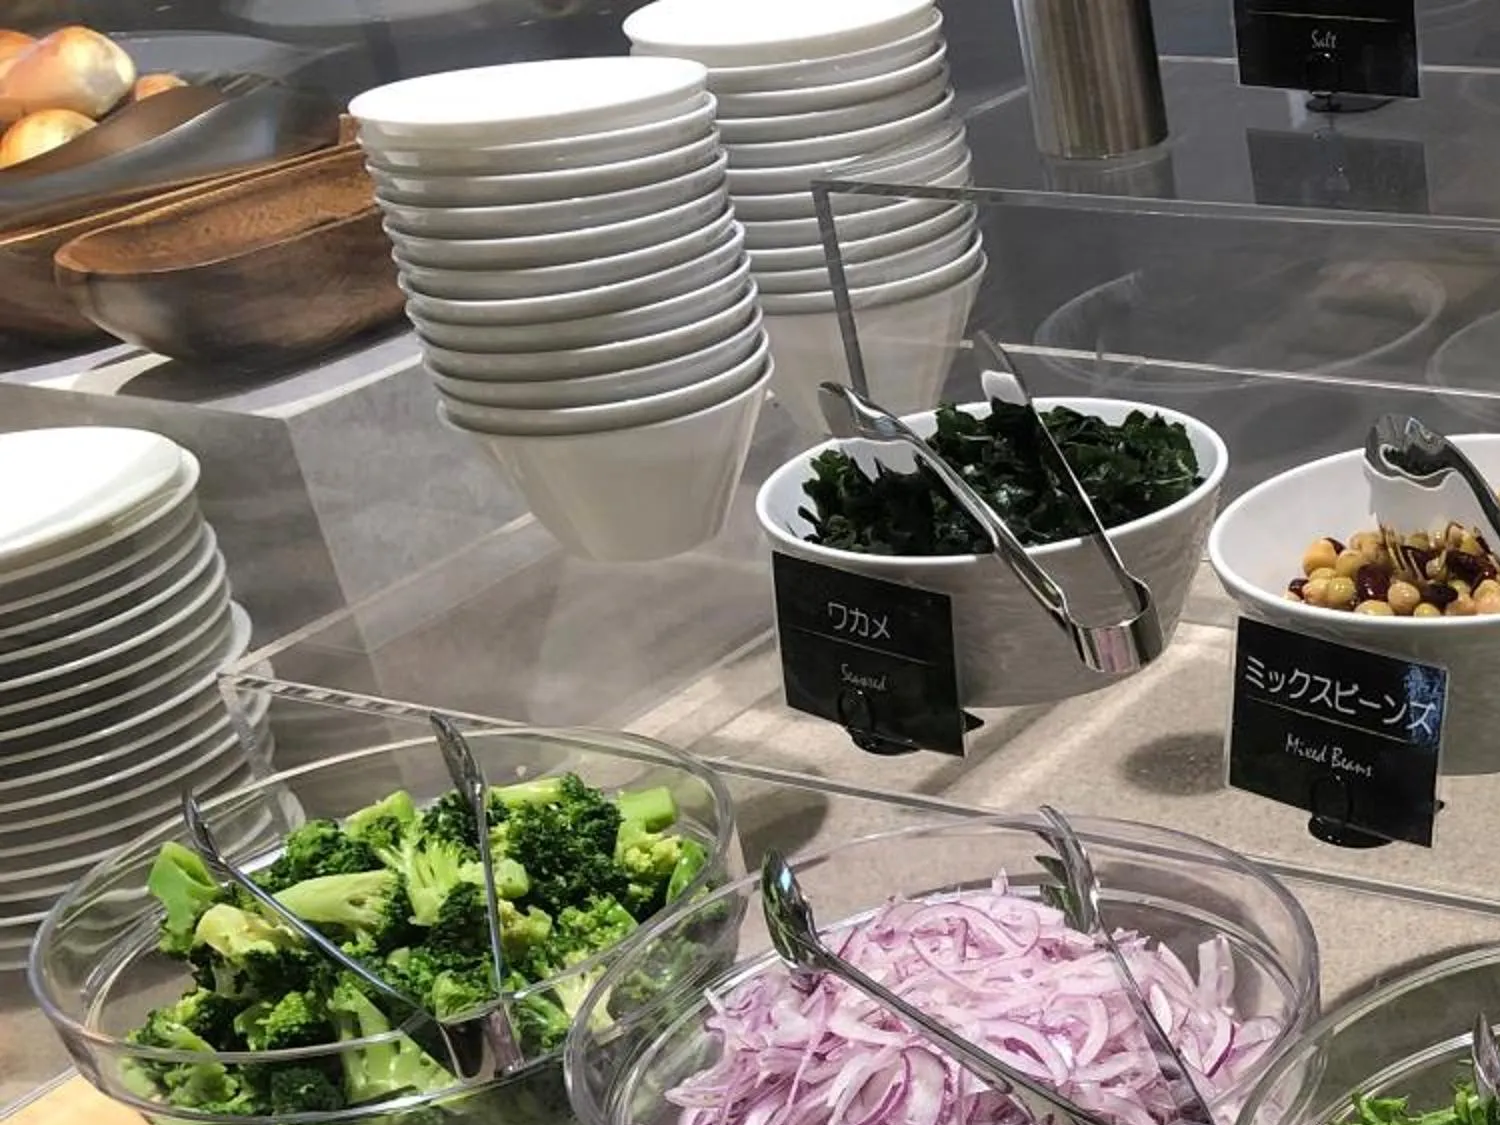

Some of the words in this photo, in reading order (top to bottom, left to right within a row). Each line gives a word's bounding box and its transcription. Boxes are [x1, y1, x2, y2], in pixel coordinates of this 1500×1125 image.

[1310, 29, 1337, 49] Salt
[827, 601, 890, 639] ワカメ
[1285, 733, 1327, 763] Mixed
[1331, 746, 1373, 777] Beans
